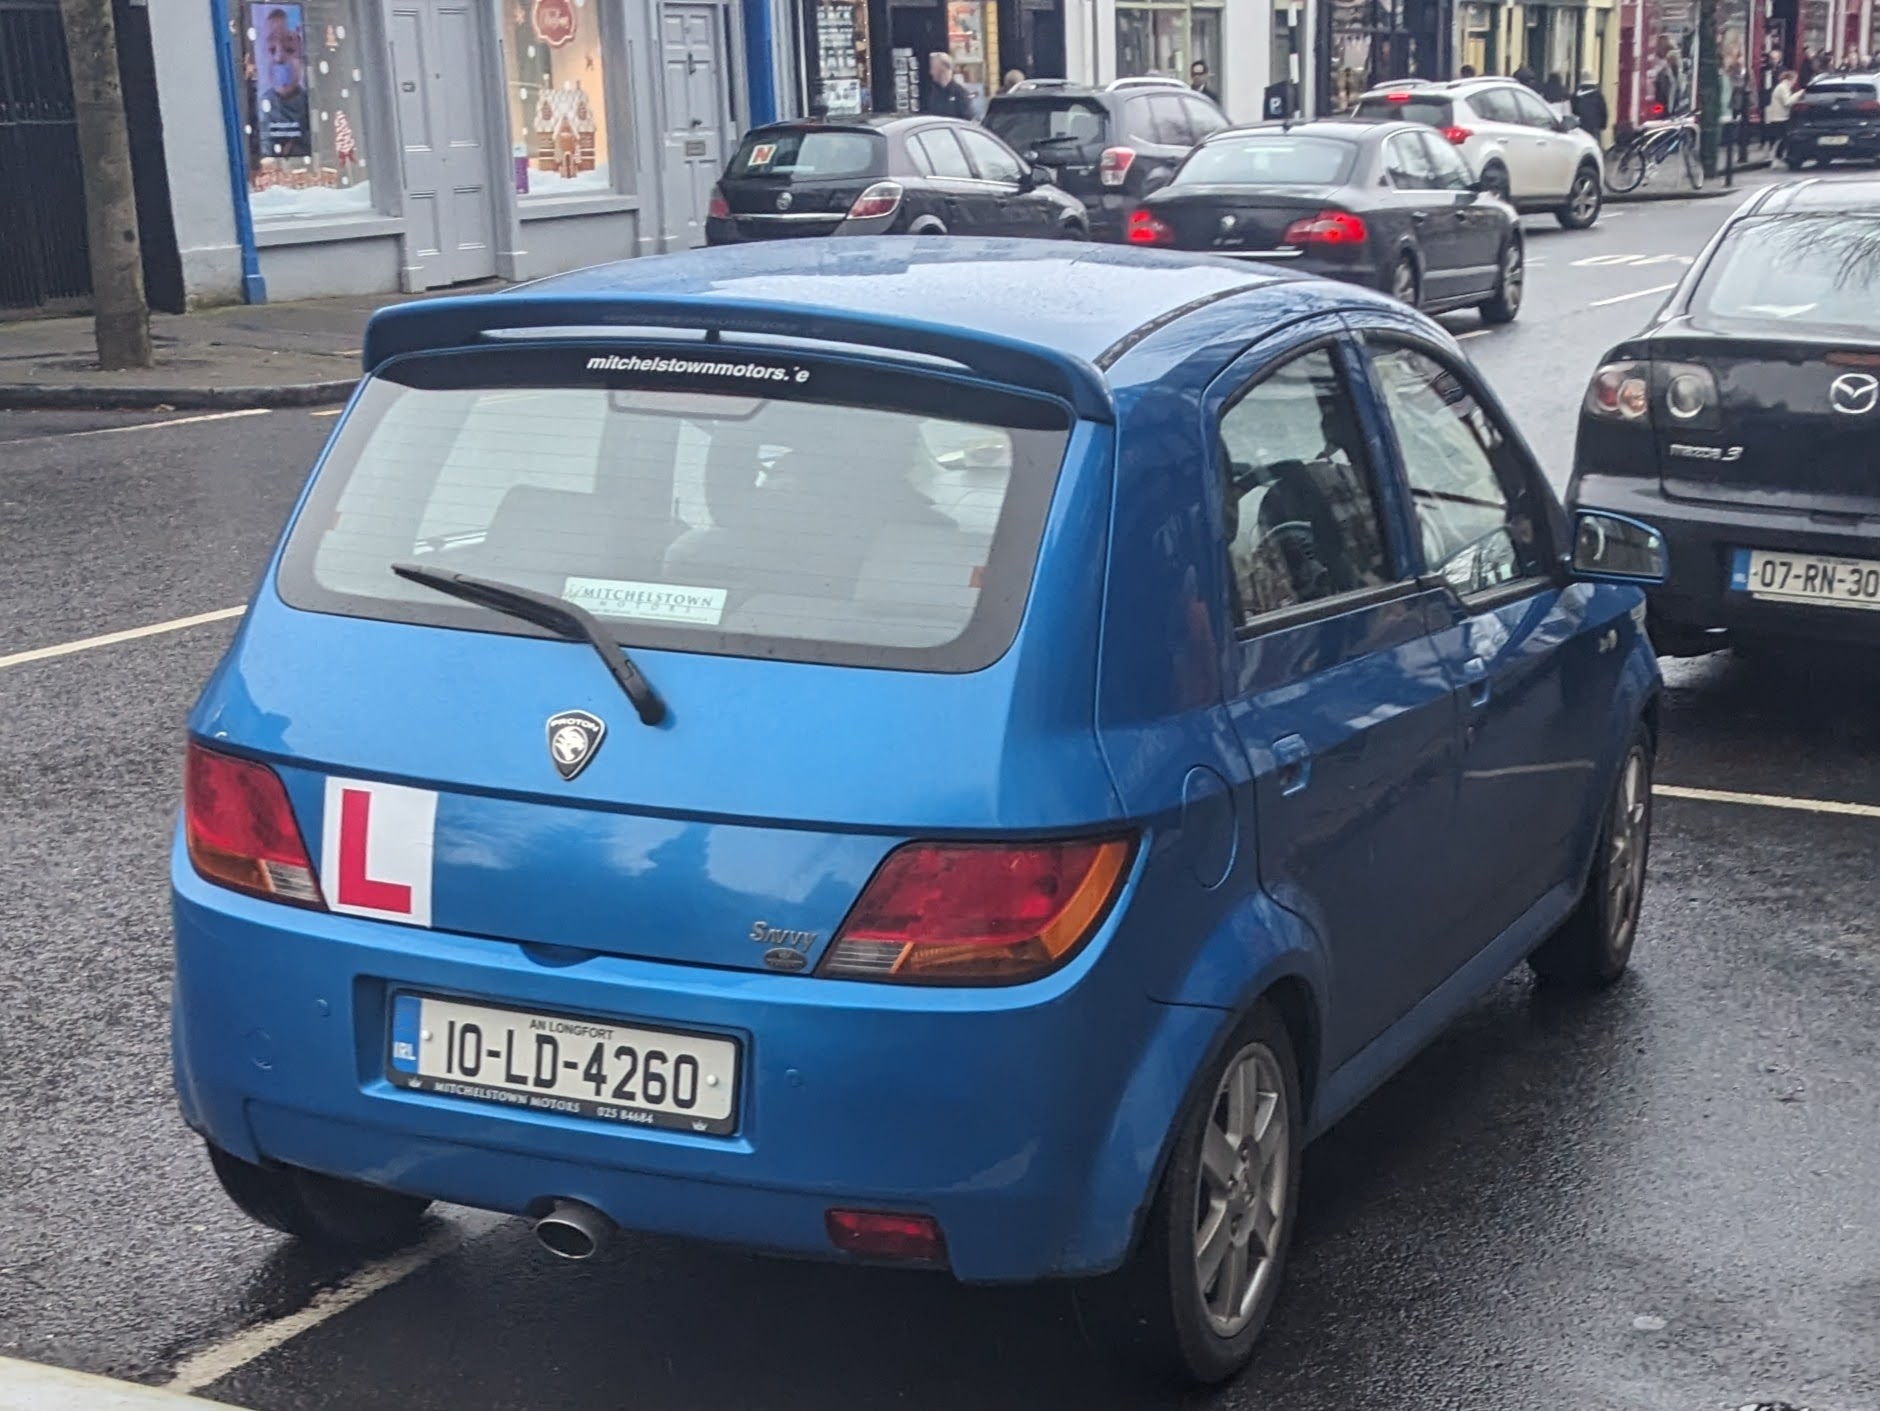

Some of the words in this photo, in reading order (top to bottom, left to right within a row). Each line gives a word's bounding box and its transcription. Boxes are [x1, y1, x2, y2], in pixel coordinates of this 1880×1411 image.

[1269, 97, 1282, 115] P
[752, 145, 774, 163] N
[583, 587, 713, 607] MITCHELSTOWN
[550, 718, 600, 732] PROTON
[337, 788, 412, 914] L
[529, 1018, 546, 1030] AN
[548, 1020, 615, 1040] LONGFORT
[393, 1041, 417, 1061] IRL
[445, 1020, 700, 1109] 10-LD-4260
[434, 1081, 529, 1104] MITCHELSTOWN
[530, 1096, 581, 1113] MOTORS
[596, 1106, 618, 1118] 025
